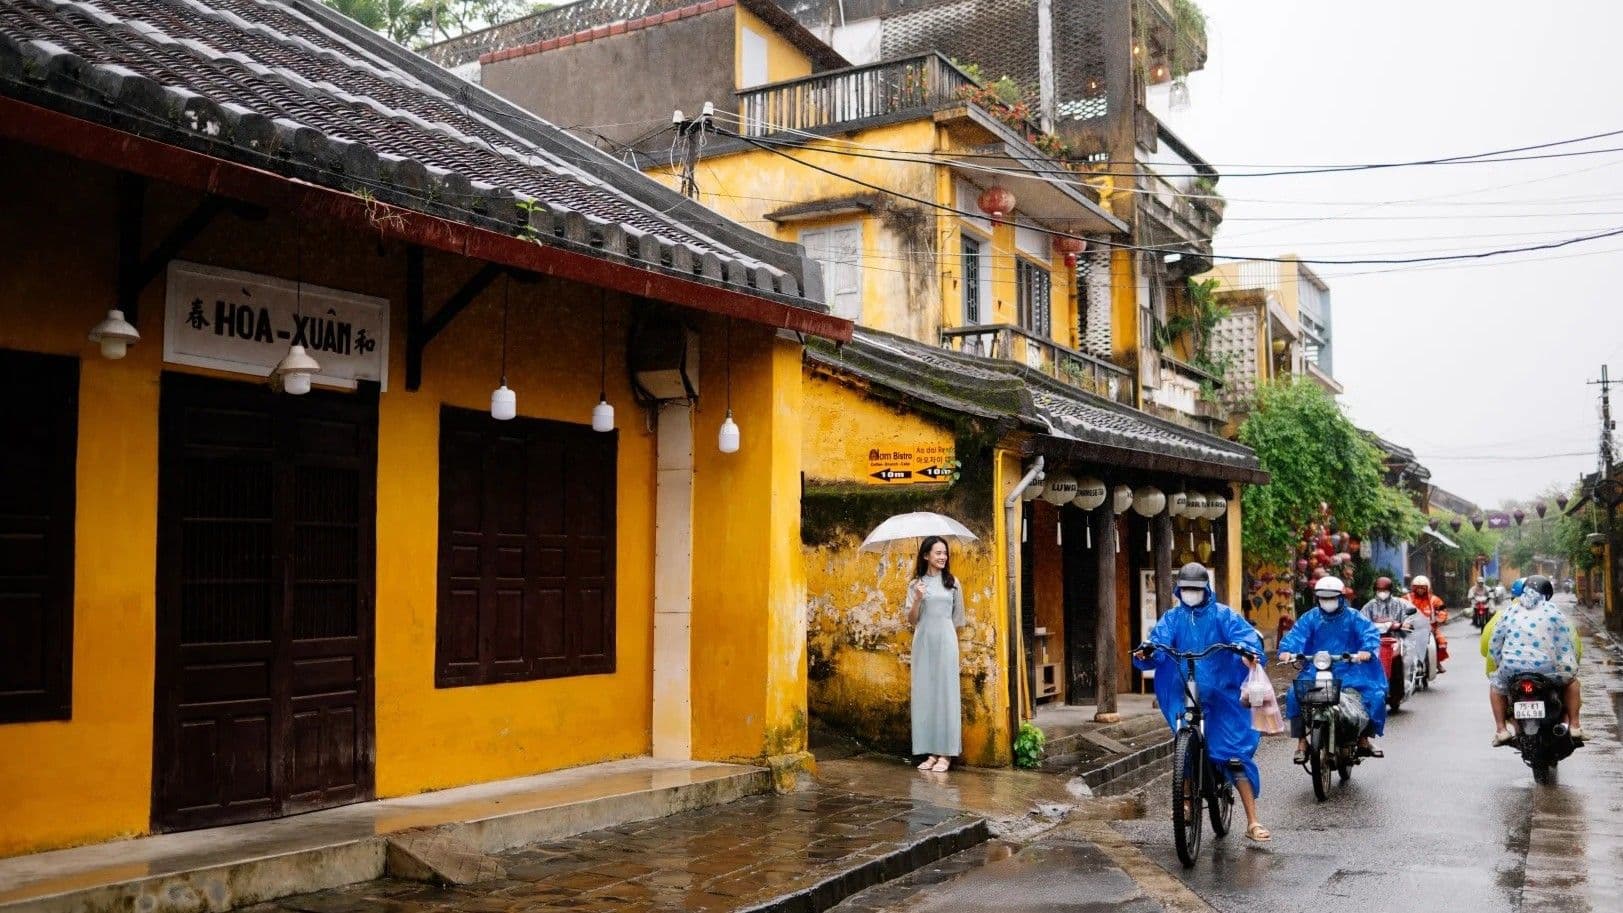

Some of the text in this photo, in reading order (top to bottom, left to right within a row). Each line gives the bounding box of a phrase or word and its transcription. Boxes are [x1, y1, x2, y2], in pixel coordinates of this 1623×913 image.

[185, 298, 210, 330] 春
[354, 328, 376, 354] 和
[893, 451, 912, 460] Bistro
[916, 456, 943, 464] 아오자이
